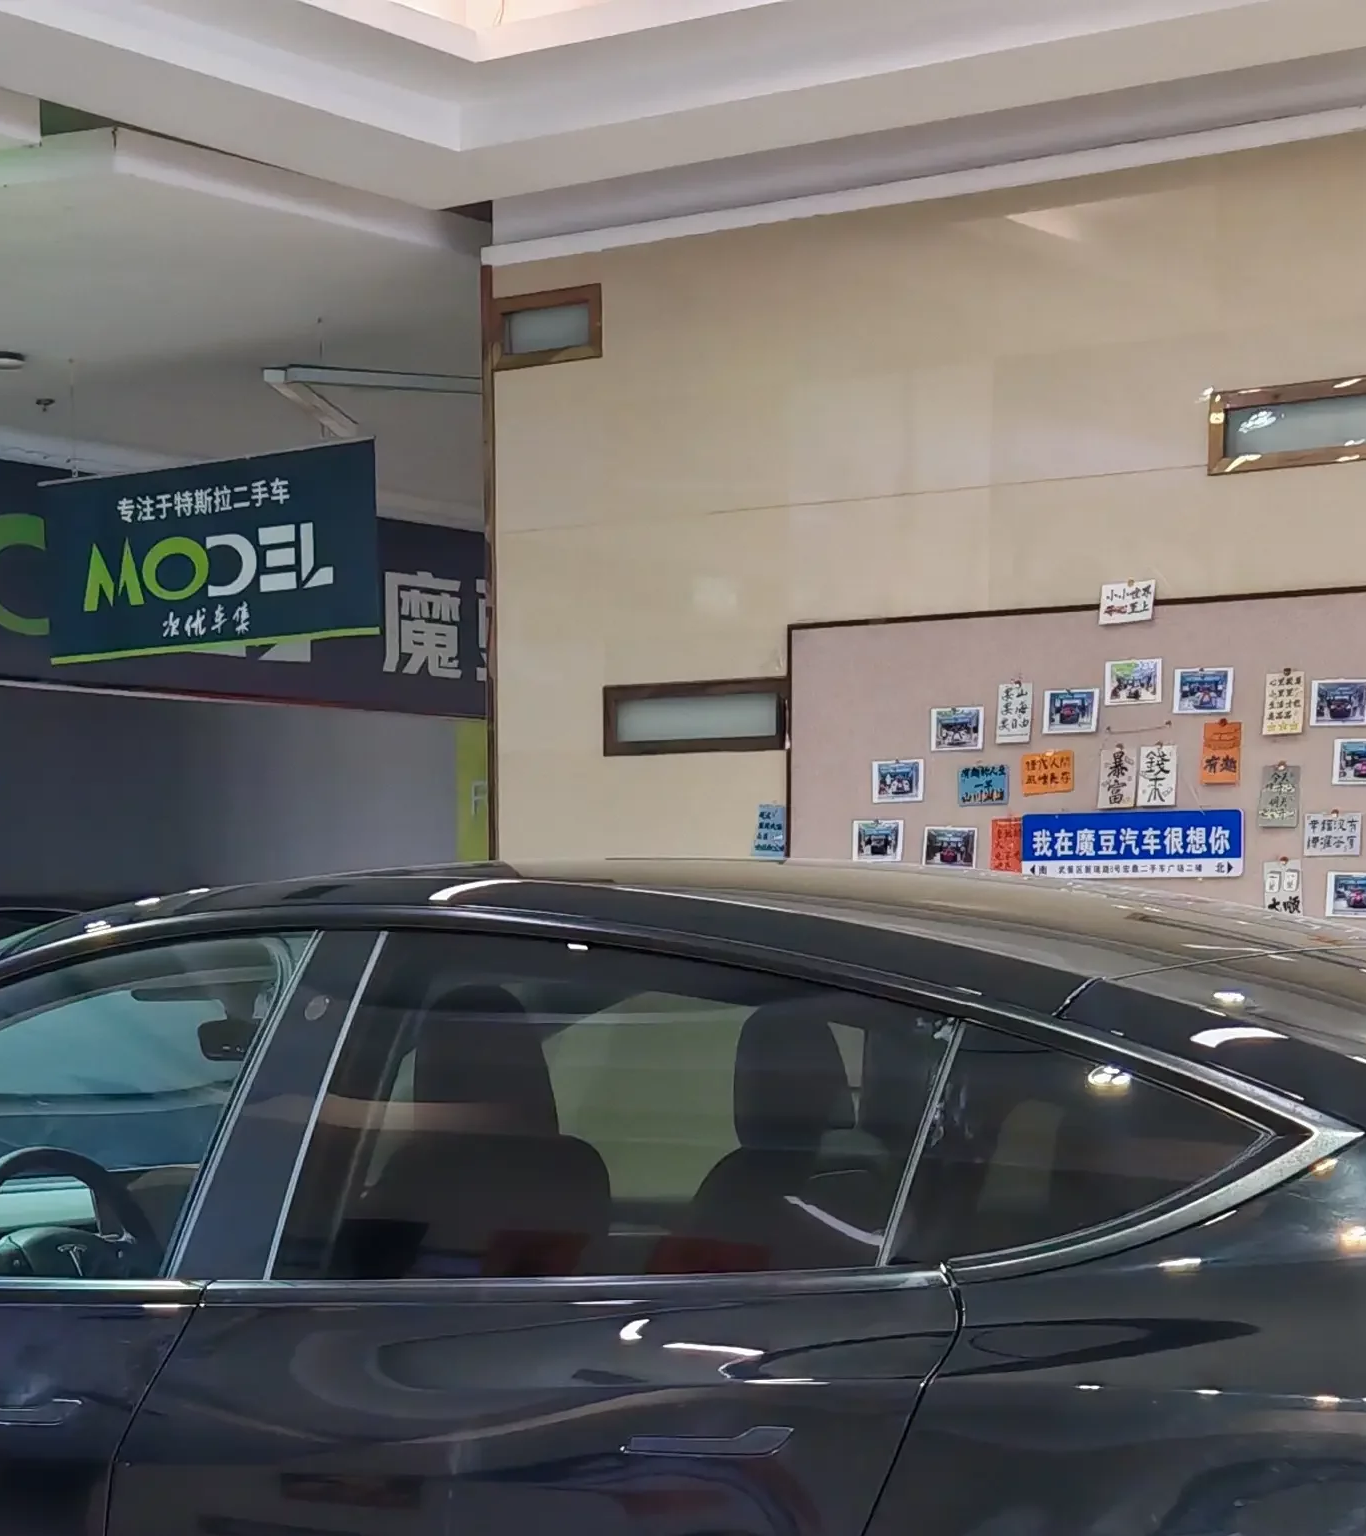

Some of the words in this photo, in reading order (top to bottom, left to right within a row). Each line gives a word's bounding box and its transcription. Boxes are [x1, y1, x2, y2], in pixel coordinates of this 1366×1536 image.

[117, 476, 291, 524] 专注于特斯拉二手车
[83, 521, 334, 613] MODEL
[382, 570, 487, 682] 魔
[1031, 825, 1232, 858] 我在魔豆汽车很想你
